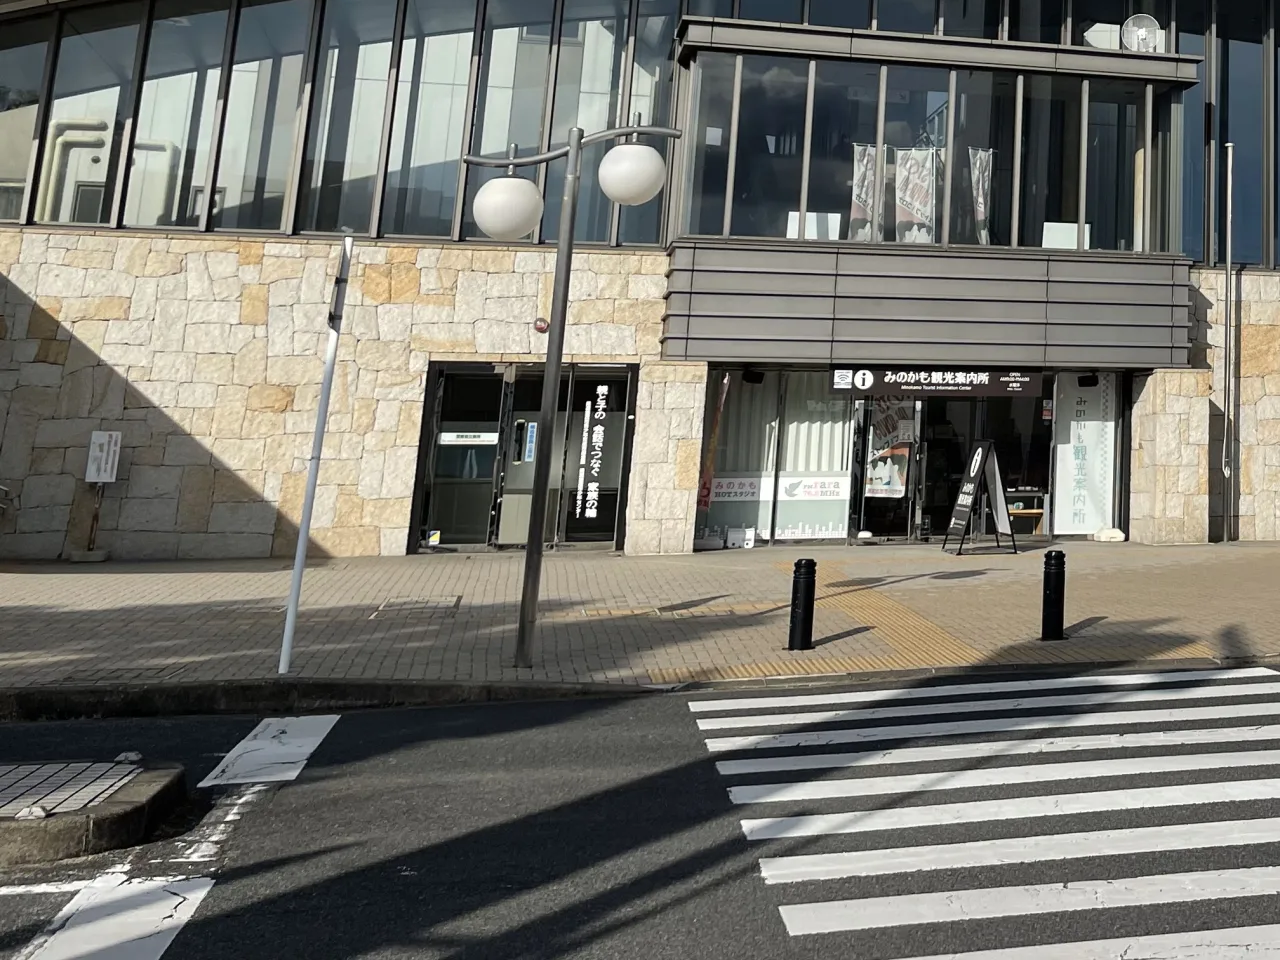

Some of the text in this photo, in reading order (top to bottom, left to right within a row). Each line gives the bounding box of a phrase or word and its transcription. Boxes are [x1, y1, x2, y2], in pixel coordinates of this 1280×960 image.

[883, 371, 990, 385] みのかも観光案内所
[1072, 396, 1088, 524] みのかも観光案内所
[715, 481, 757, 490] みのかも
